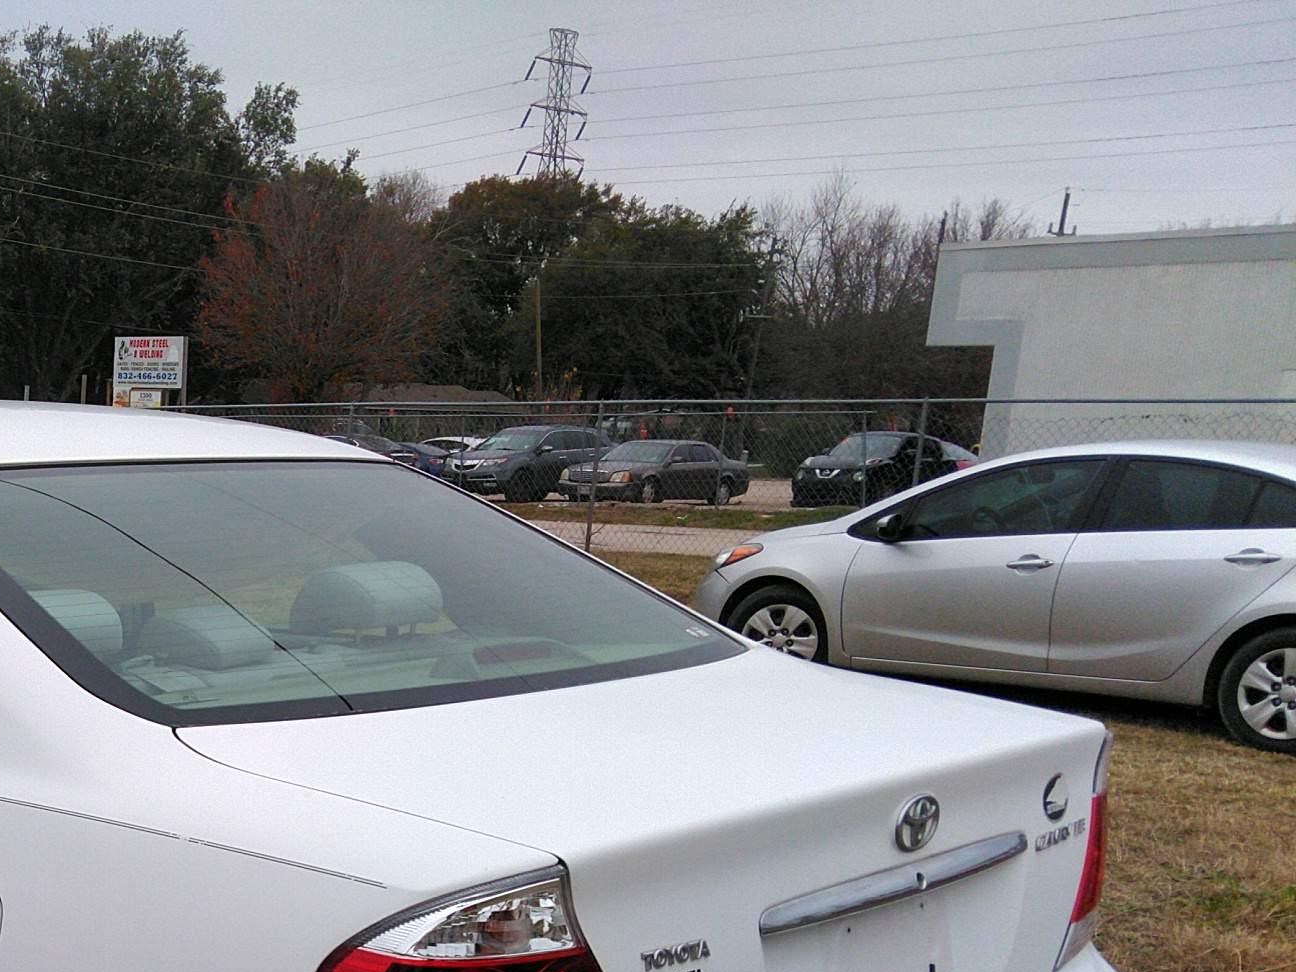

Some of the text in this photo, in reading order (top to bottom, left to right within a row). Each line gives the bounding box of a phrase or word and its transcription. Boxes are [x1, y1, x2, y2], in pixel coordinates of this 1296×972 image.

[129, 339, 169, 348] MODERN STEEL
[139, 350, 163, 358] WELDING
[640, 939, 710, 972] TOYOTA
